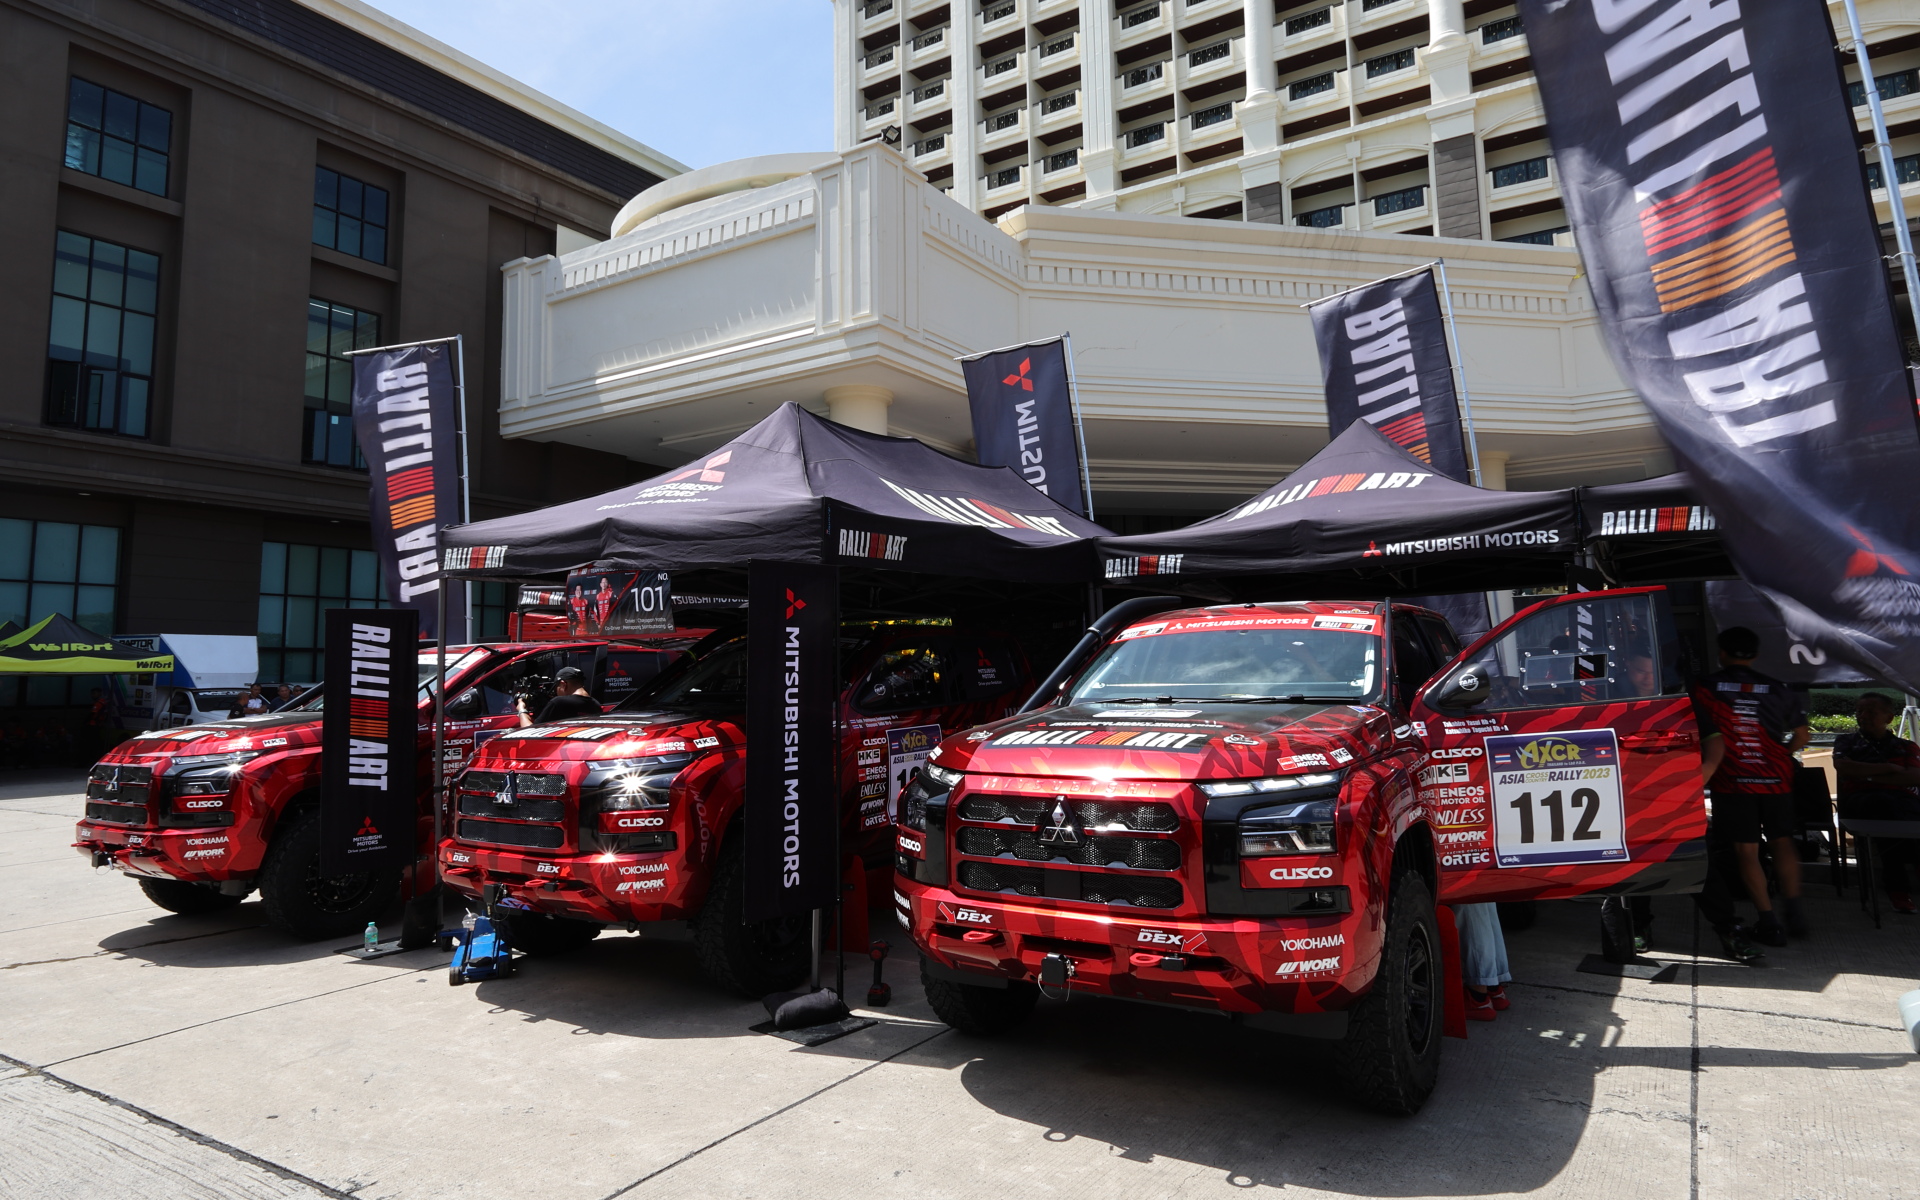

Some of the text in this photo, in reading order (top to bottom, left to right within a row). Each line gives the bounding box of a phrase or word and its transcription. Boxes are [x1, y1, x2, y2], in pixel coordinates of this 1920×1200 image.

[635, 490, 700, 499] MOTORS
[638, 483, 724, 494] MITSUBISHI
[1228, 472, 1433, 522] RALLI ART
[1601, 509, 1657, 535] RALLI
[838, 529, 907, 561] RALLI ART
[1386, 529, 1559, 556] MITSUBISHI MOTORS
[443, 545, 508, 570] RALLI ART
[1104, 554, 1184, 578] RALLI ART
[521, 591, 564, 606] RALLI ART
[630, 586, 664, 613] 101
[1186, 618, 1309, 629] MITSUBISHI MOTORS
[349, 623, 390, 791] RALLI ART
[656, 741, 685, 749] ENEOS
[694, 738, 718, 747] HKS
[863, 737, 886, 746] CUSCO
[992, 730, 1207, 748] RALLI ART
[783, 627, 800, 888] MITSUBISHI MOTORS
[859, 750, 880, 761] HKS
[1292, 753, 1327, 762] ENEOS
[1333, 749, 1350, 760] HKS
[1432, 747, 1482, 759] CUSCO
[1516, 737, 1583, 769] AXCR
[866, 765, 886, 775] ENEOS
[1499, 768, 1610, 785] ASIA RALLY 2023
[860, 782, 887, 797] ENDLESS
[983, 777, 1156, 795] MITSUBISHI
[1440, 786, 1484, 797] ENEOS
[187, 800, 223, 809] CUSCO
[1441, 798, 1470, 806] MOTOR
[618, 817, 664, 827] CUSCO
[865, 814, 886, 827] ORTEC
[1436, 808, 1486, 825] NDLESS
[1510, 788, 1601, 844] 112
[129, 836, 143, 844] DEX
[186, 836, 229, 846] YOKOHAMA
[1449, 831, 1487, 842] WORK
[900, 836, 921, 852] CUSCO
[198, 848, 225, 856] WORK
[453, 853, 470, 863] DEX
[1442, 853, 1490, 866] ORTEC
[537, 864, 560, 874] DEX
[618, 863, 669, 875] YOKOHAMA
[1269, 866, 1333, 880] CUSCO
[632, 878, 665, 889] WORK
[957, 911, 993, 923] DEX
[1137, 932, 1183, 944] DEX
[1280, 934, 1345, 951] YOKOHAMA
[1298, 956, 1340, 970] WORK
[1282, 969, 1335, 980] WHEELS
